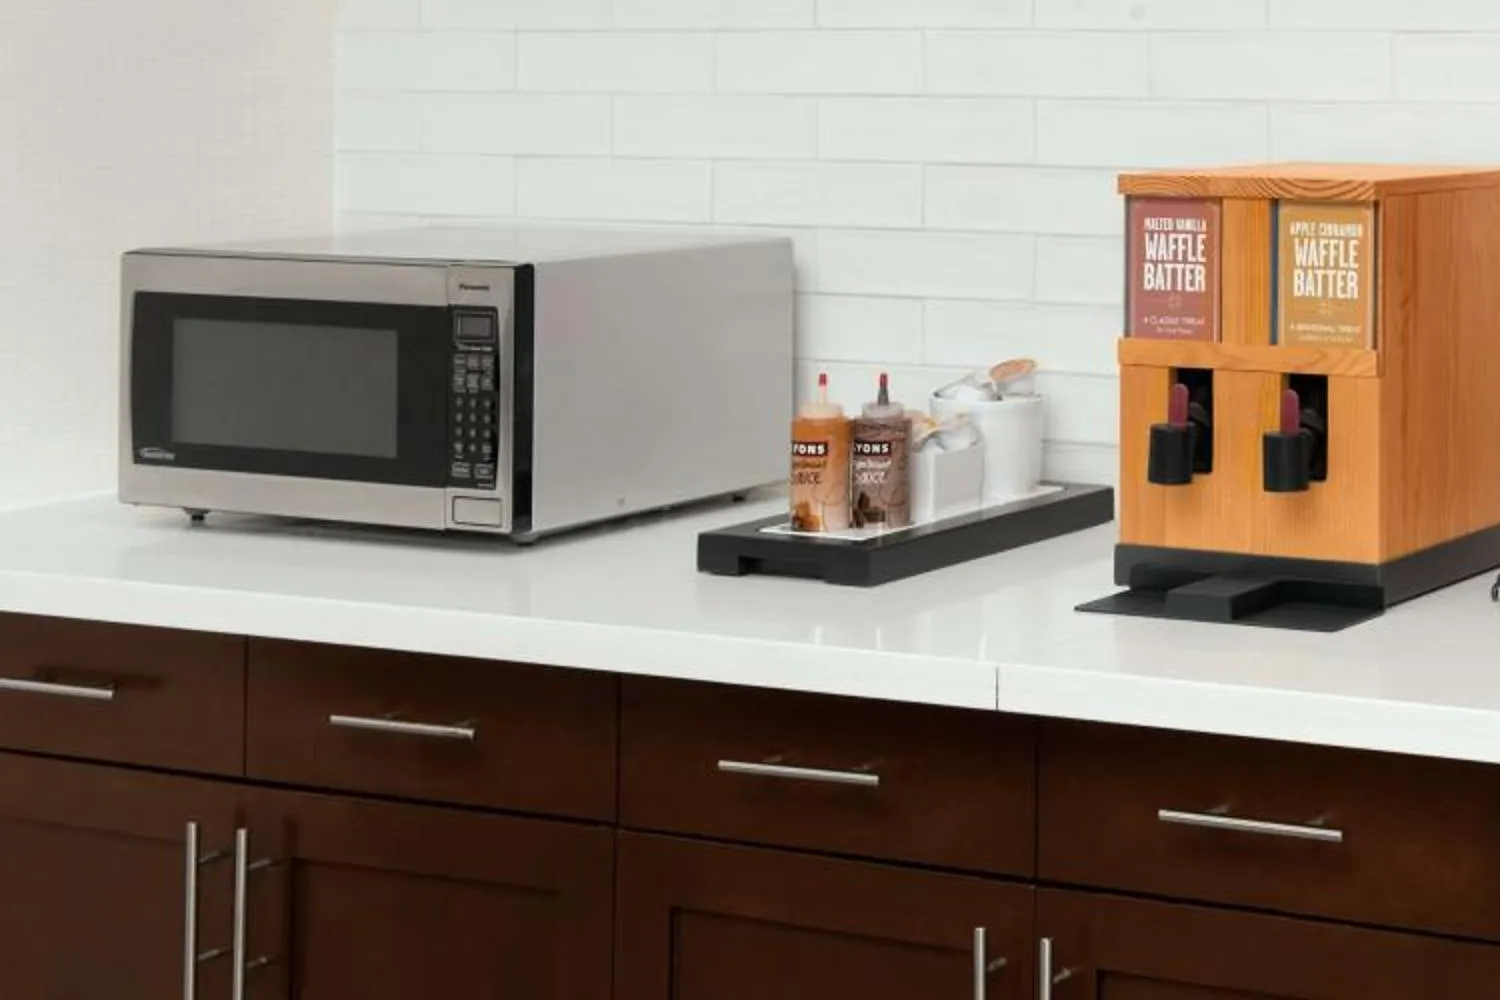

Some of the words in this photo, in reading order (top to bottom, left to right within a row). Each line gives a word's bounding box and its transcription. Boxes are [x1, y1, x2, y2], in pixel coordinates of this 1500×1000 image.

[1144, 232, 1207, 262] WAFFLE
[1294, 237, 1360, 269] WAFFLE
[1143, 263, 1206, 292] BATTER
[1293, 269, 1359, 299] BATTER
[853, 443, 889, 455] YONS
